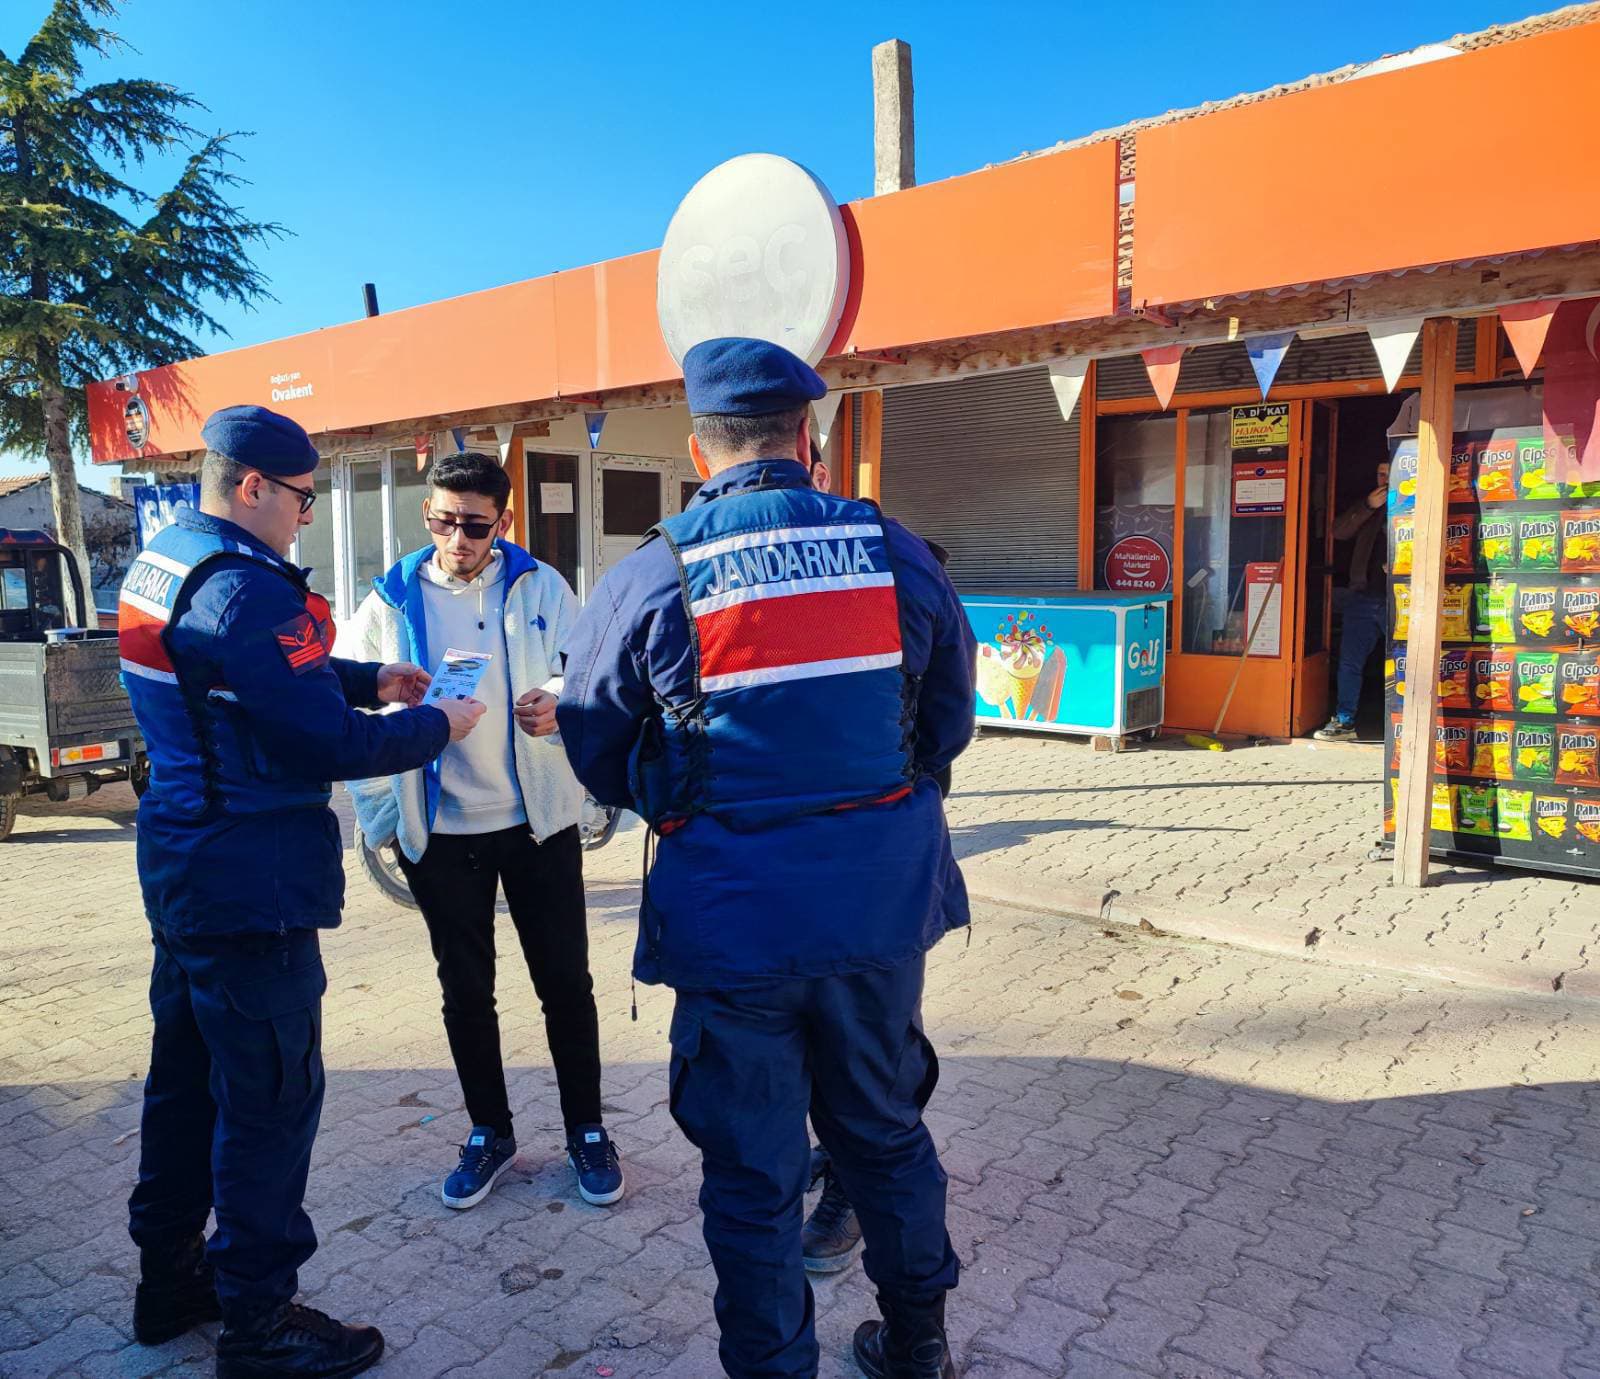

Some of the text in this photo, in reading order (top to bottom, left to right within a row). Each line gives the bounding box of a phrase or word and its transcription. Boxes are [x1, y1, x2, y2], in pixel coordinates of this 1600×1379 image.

[271, 383, 313, 402] Ovakent
[1480, 450, 1512, 465] Cipso
[1480, 521, 1512, 539] Patos
[1520, 520, 1555, 538] Patos
[1114, 552, 1161, 561] Mahallenizin
[1123, 561, 1151, 569] Marketi
[706, 539, 876, 595] JANDARMA
[1115, 579, 1132, 587] 444
[1520, 591, 1554, 608] Patos
[1563, 591, 1599, 608] Patos
[1127, 638, 1161, 670] Golf
[1478, 660, 1511, 676] Cipso
[1520, 662, 1555, 678] Cipso
[1563, 663, 1600, 680] Cipso
[1475, 729, 1510, 745] Patos
[1516, 730, 1552, 748] Patos
[1560, 733, 1598, 750] Patos
[1537, 800, 1567, 813] Patos
